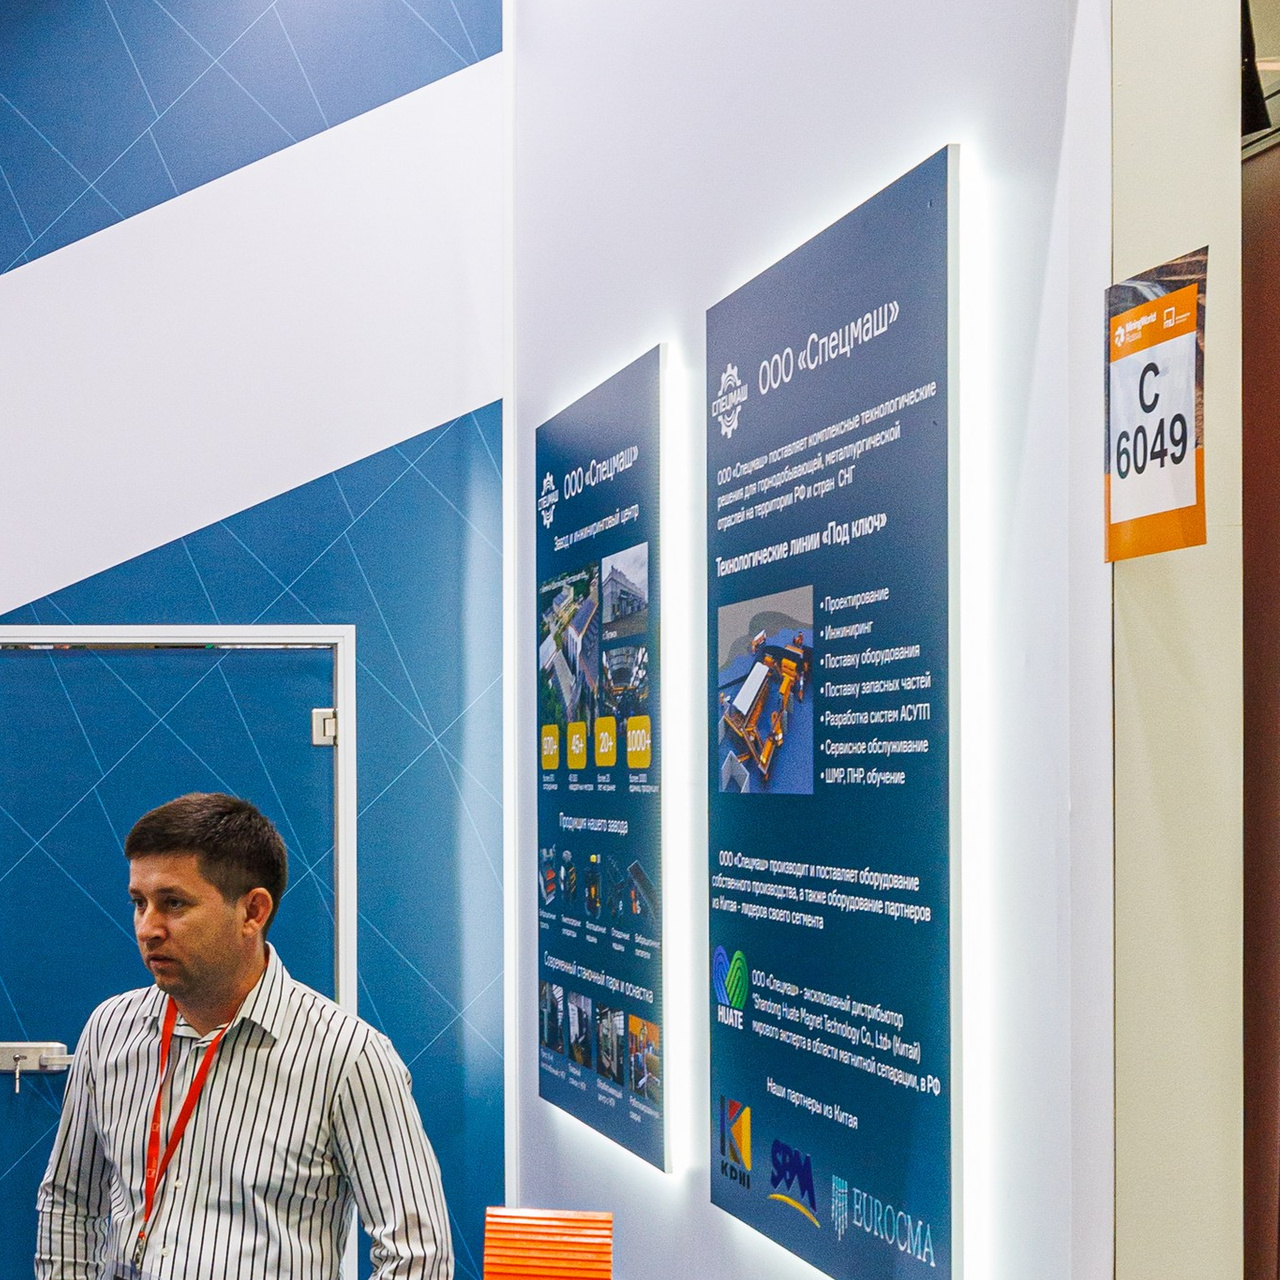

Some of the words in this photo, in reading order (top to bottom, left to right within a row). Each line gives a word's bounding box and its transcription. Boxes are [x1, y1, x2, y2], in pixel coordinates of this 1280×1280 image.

[758, 346, 794, 395] ООО
[797, 300, 900, 371] «Спецмаш»
[711, 383, 748, 417] СПЕЦМАШ
[717, 466, 732, 486] ООО
[732, 455, 768, 480] «Спецмаш»
[769, 436, 807, 464] поставляет
[808, 414, 860, 448] комплексные
[861, 381, 937, 426] технологические
[825, 421, 901, 466] металлургической
[1116, 412, 1188, 480] 6049
[563, 466, 584, 500] ООО
[584, 445, 639, 487] «Спецмаш»
[717, 506, 745, 532] отраслей
[746, 508, 754, 521] на
[754, 491, 793, 519] территории
[794, 483, 806, 503] РФ
[807, 485, 812, 498] и
[813, 477, 835, 498] стран
[838, 465, 856, 487] СНГ
[715, 541, 789, 578] Технологические
[789, 531, 820, 557] линии
[821, 521, 850, 546] «Под
[851, 512, 888, 539] ключ»
[824, 587, 890, 615] Проектирование
[824, 621, 874, 640] Инжиниринг
[824, 653, 860, 669] Поставку
[860, 644, 920, 666] оборудования
[824, 681, 860, 699] Поставку
[861, 678, 900, 695] запасных
[900, 671, 931, 690] частей
[824, 709, 869, 729] Разработка
[869, 709, 899, 724] систем
[899, 702, 931, 722] АСУТП
[571, 734, 584, 754] 45+
[599, 731, 613, 754] 20+
[626, 729, 651, 752] 1000+
[824, 739, 867, 758] Сервисное
[867, 737, 929, 757] обслуживание
[866, 767, 906, 788] обучение
[719, 850, 734, 867] ООО
[769, 859, 809, 879] производит
[809, 864, 815, 877] и
[815, 865, 859, 883] поставляет
[859, 866, 920, 891] оборудование
[711, 872, 751, 893] собственного
[799, 888, 805, 901] а
[805, 888, 827, 904] также
[827, 889, 884, 914] оборудование
[884, 901, 931, 925] партнеров
[741, 902, 768, 920] лидеров
[768, 907, 791, 923] своего
[791, 911, 824, 930] сегмента
[717, 1004, 744, 1030] HUATE
[752, 969, 766, 988] ООО
[803, 987, 851, 1012] эксклюзивный
[851, 1001, 904, 1031] дистрибьютор
[782, 1001, 800, 1022] Huate
[800, 1007, 823, 1031] Magnet
[823, 1014, 860, 1045] Technology
[892, 1034, 921, 1065] (Китай)
[812, 1037, 838, 1061] области
[838, 1049, 876, 1074] магнитной
[920, 1077, 926, 1092] в
[926, 1074, 941, 1097] РФ
[766, 1076, 787, 1100] Наши
[787, 1089, 823, 1115] партнеры
[823, 1104, 833, 1119] из
[833, 1104, 858, 1129] Китая
[852, 1186, 936, 1268] EUROCMA
